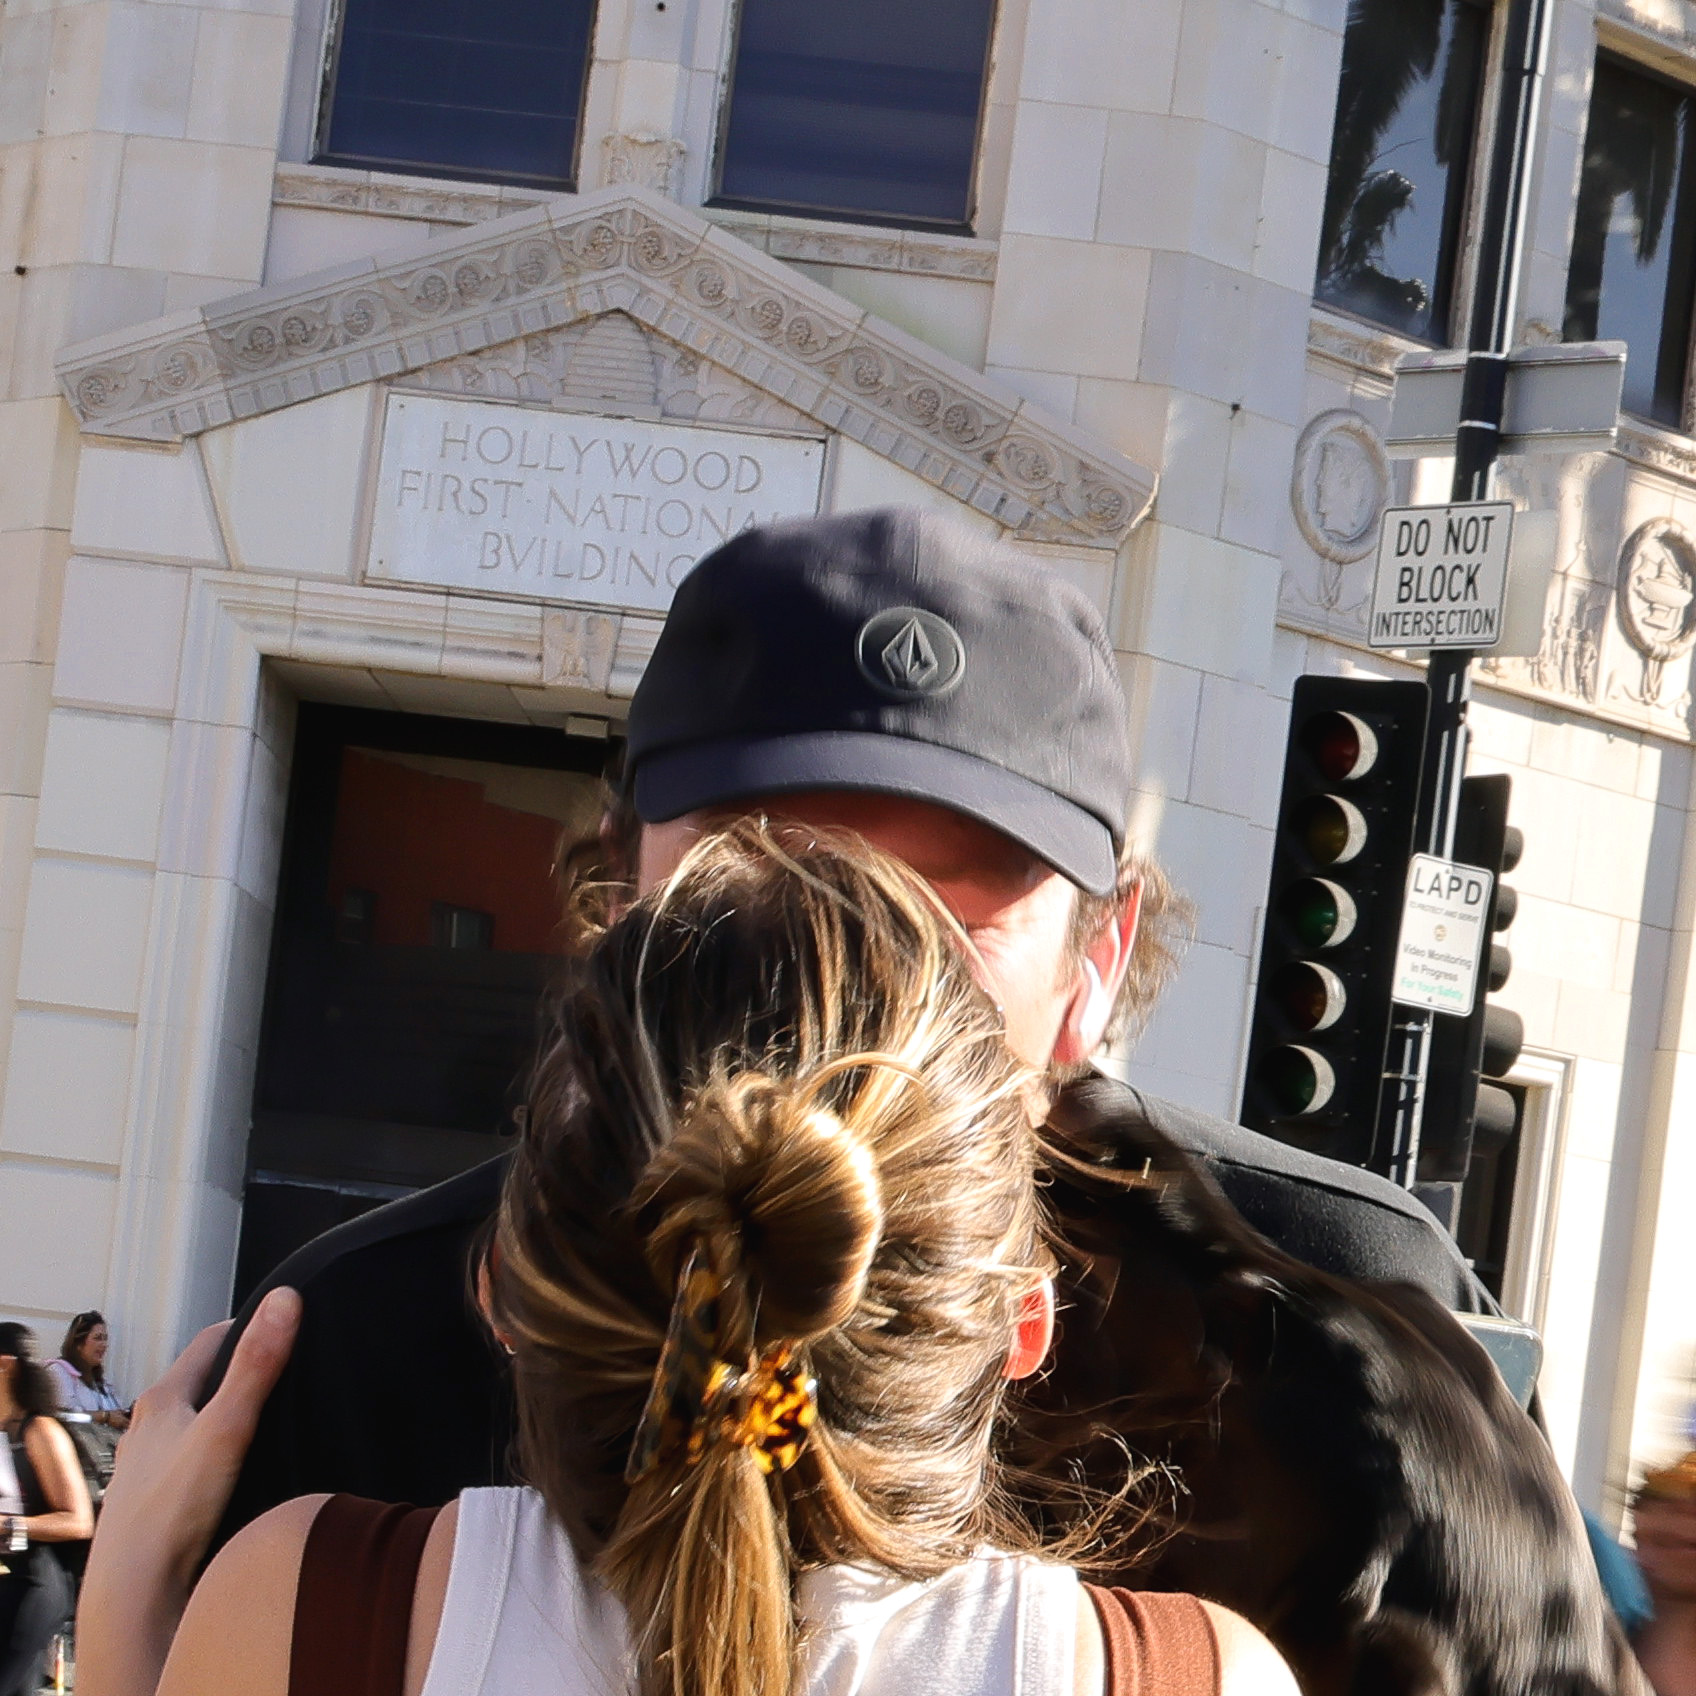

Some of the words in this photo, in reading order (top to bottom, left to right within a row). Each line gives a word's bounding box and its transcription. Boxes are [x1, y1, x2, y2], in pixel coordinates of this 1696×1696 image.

[438, 420, 763, 495] HOLLYWOOD
[395, 469, 524, 519] FIRST
[543, 484, 780, 541] NATION
[1395, 518, 1431, 557] DO
[1443, 516, 1496, 555] NOT
[1397, 563, 1482, 604] BLOCK
[1373, 607, 1497, 637] INTERSECTION
[1413, 867, 1483, 906] LAPD
[1403, 943, 1426, 958] Video
[1428, 948, 1473, 971] Monitoring
[1420, 964, 1459, 982] Progress
